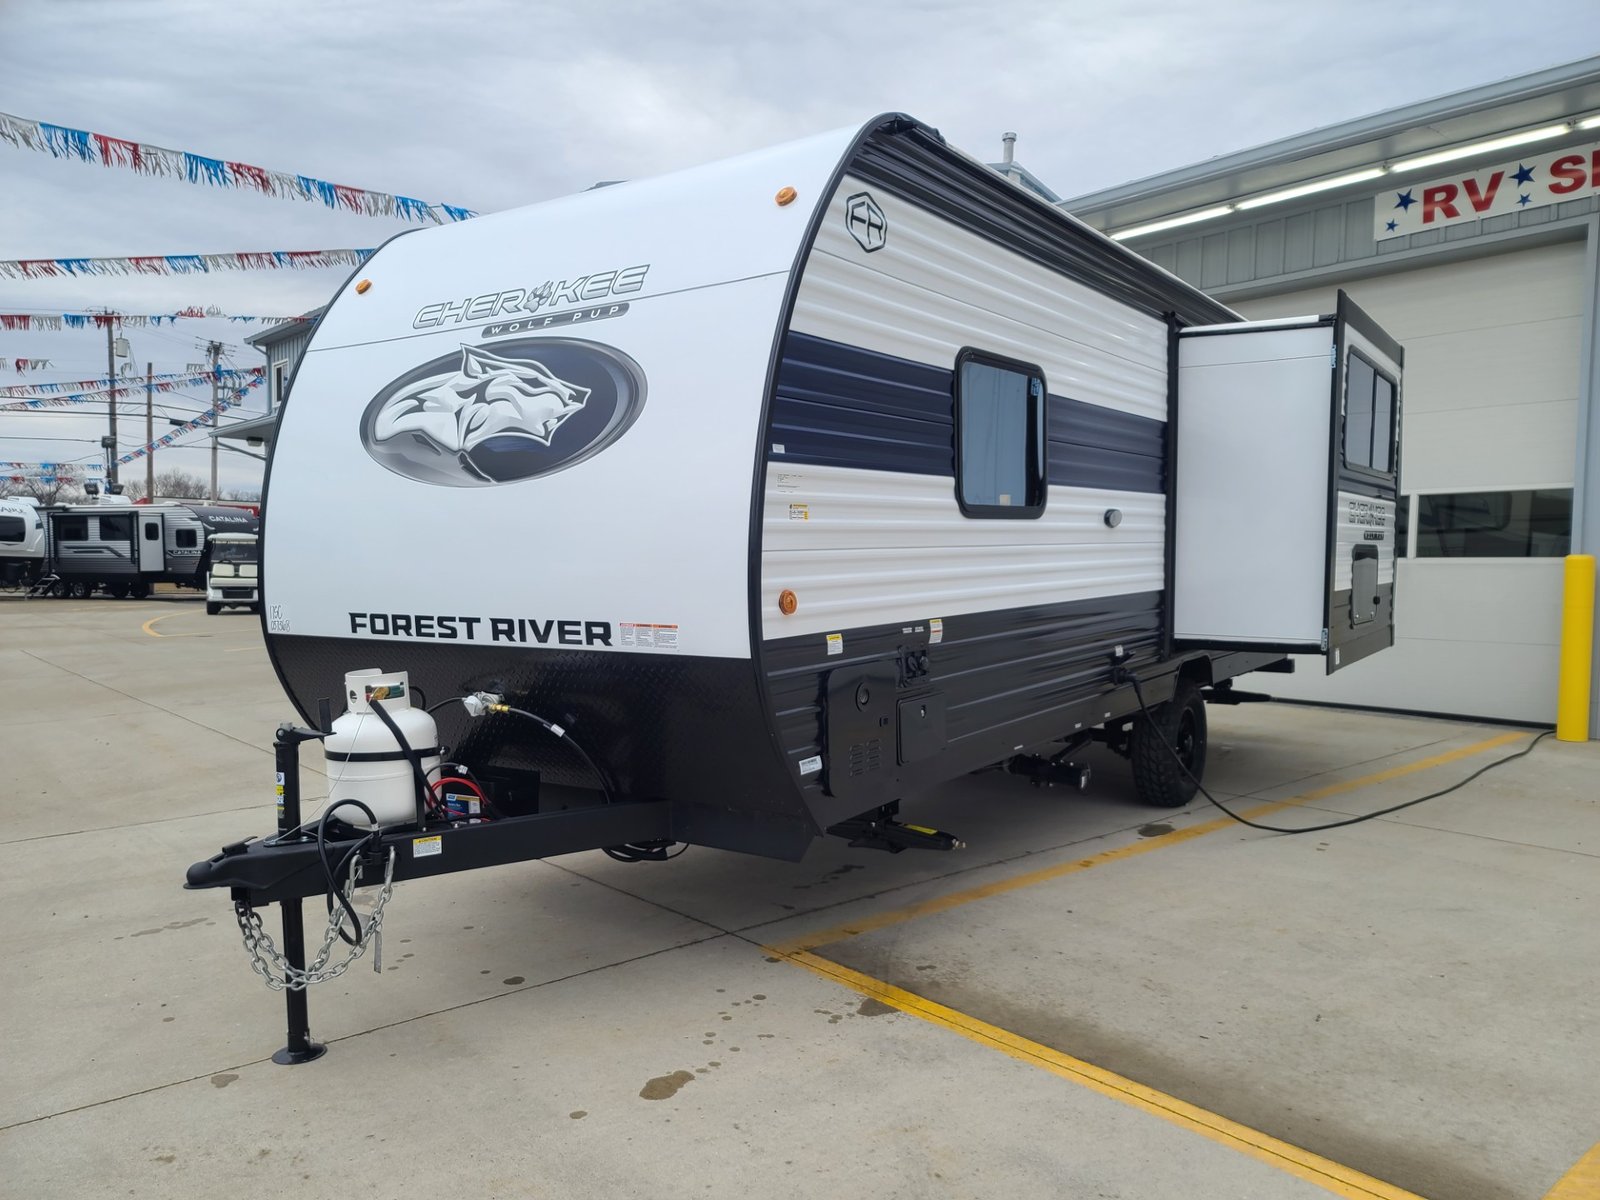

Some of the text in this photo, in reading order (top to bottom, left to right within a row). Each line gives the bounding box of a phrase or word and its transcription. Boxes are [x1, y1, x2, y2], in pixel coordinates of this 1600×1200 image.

[1422, 150, 1600, 224] RV S
[491, 305, 620, 335] WOLF PUP
[208, 515, 249, 523] CATALINA
[348, 612, 482, 639] FOREST
[489, 617, 613, 646] RIVER
